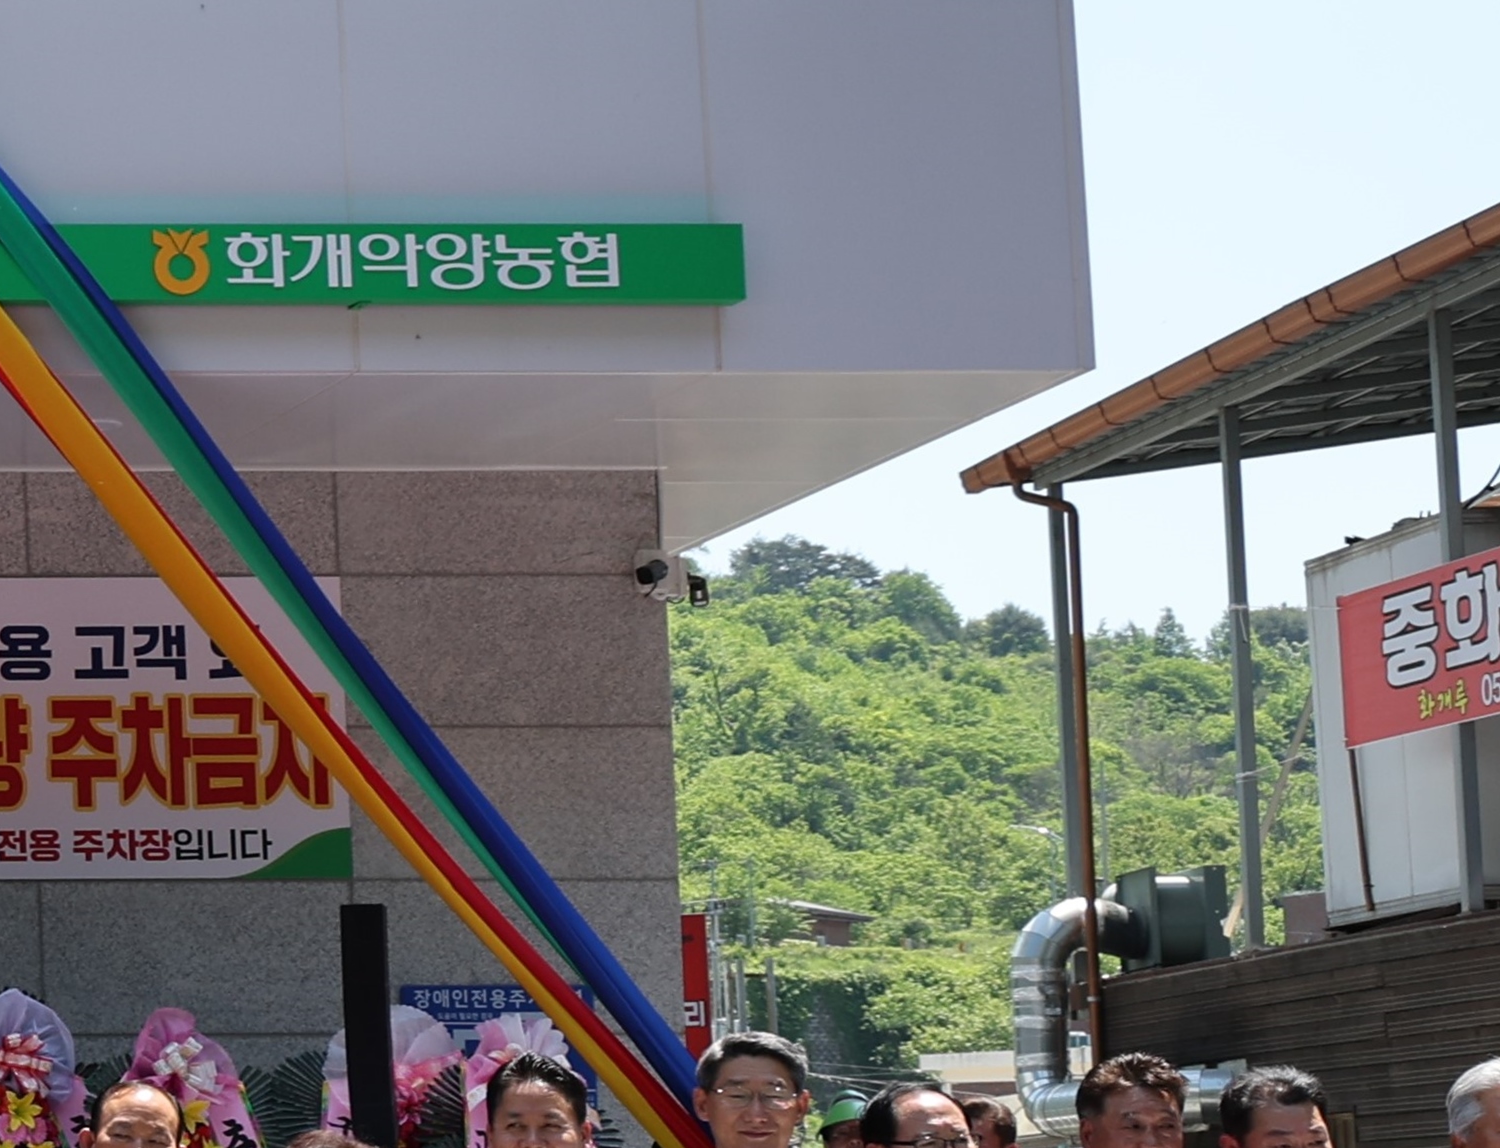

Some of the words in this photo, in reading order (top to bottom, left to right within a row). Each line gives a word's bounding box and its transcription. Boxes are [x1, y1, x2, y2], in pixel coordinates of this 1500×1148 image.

[224, 232, 620, 291] 화개악양농협
[74, 625, 188, 681] 고객
[1417, 677, 1470, 721] 화개루
[72, 828, 273, 863] 주차장입니다
